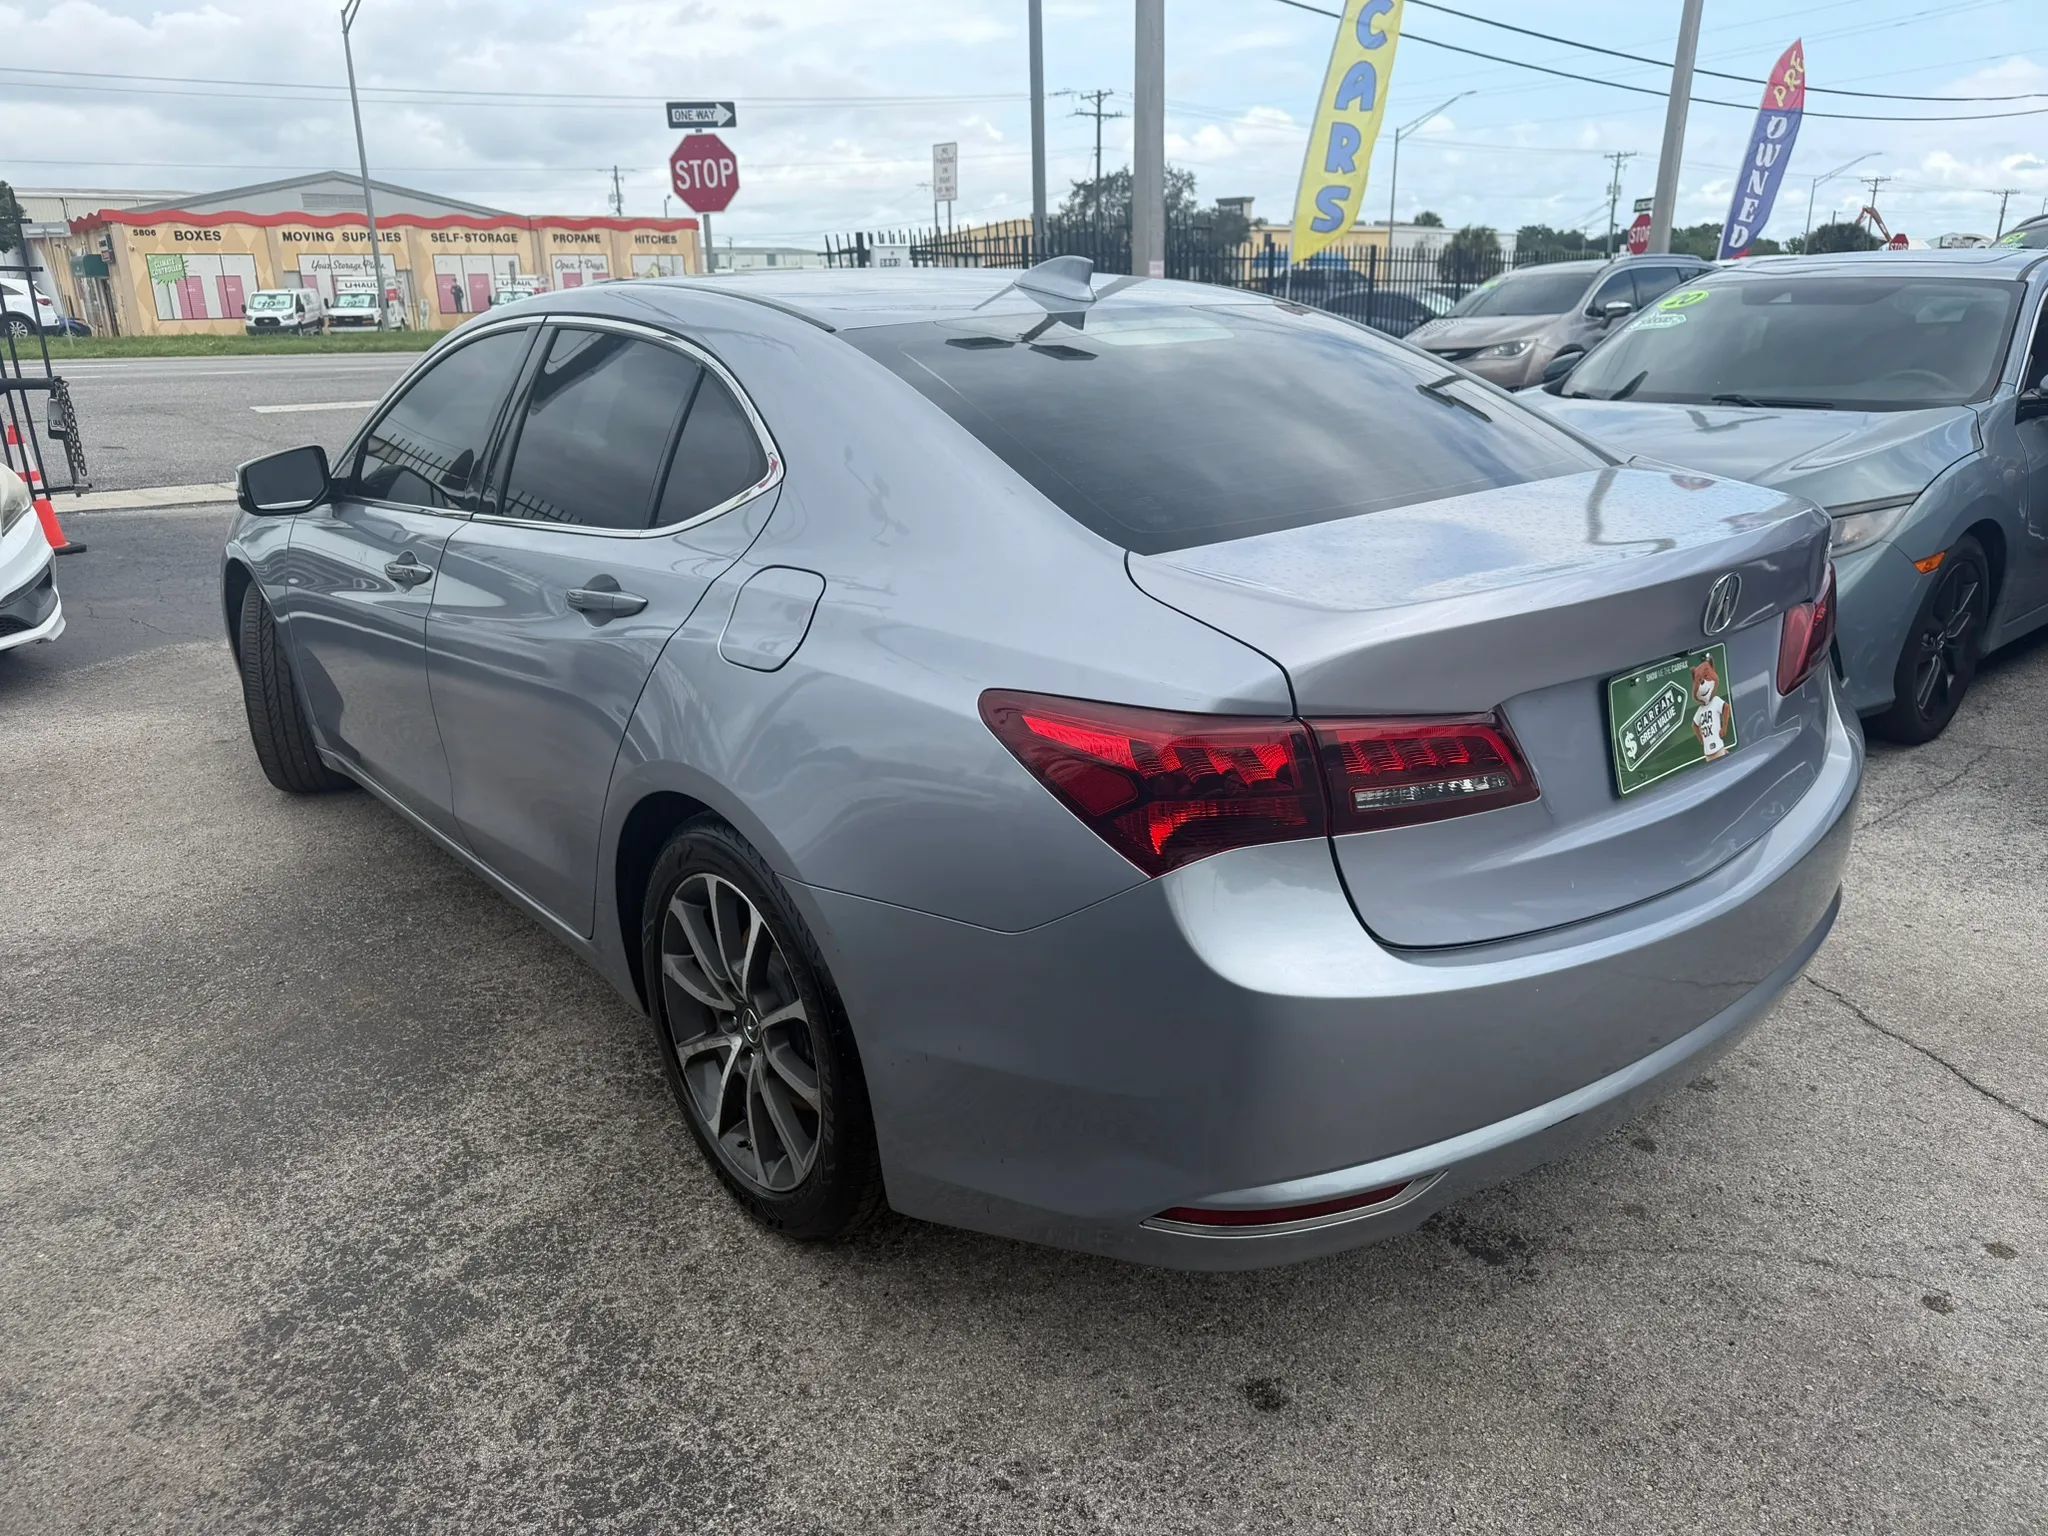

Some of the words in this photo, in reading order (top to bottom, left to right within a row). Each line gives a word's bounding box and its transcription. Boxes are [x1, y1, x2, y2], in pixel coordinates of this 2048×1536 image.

[674, 110, 694, 121] ONE
[696, 110, 716, 120] WAY
[1310, 0, 1394, 234] CARS
[675, 158, 734, 190] STOP
[1729, 115, 1788, 248] OWNED
[133, 229, 157, 237] 5806
[174, 230, 222, 242] BOXES
[282, 231, 335, 243] MOVING
[431, 232, 518, 244] SELF-STORAGE
[553, 233, 601, 244] PROPANE
[634, 234, 678, 245] HITCHES
[311, 259, 331, 272] Your
[332, 260, 363, 271] Storage
[555, 259, 575, 271] Open
[584, 259, 605, 271] Days
[1636, 690, 1675, 733] CARFAX
[1701, 710, 1713, 725] CAR
[1640, 722, 1658, 746] GREAT
[1657, 706, 1676, 728] VALUE
